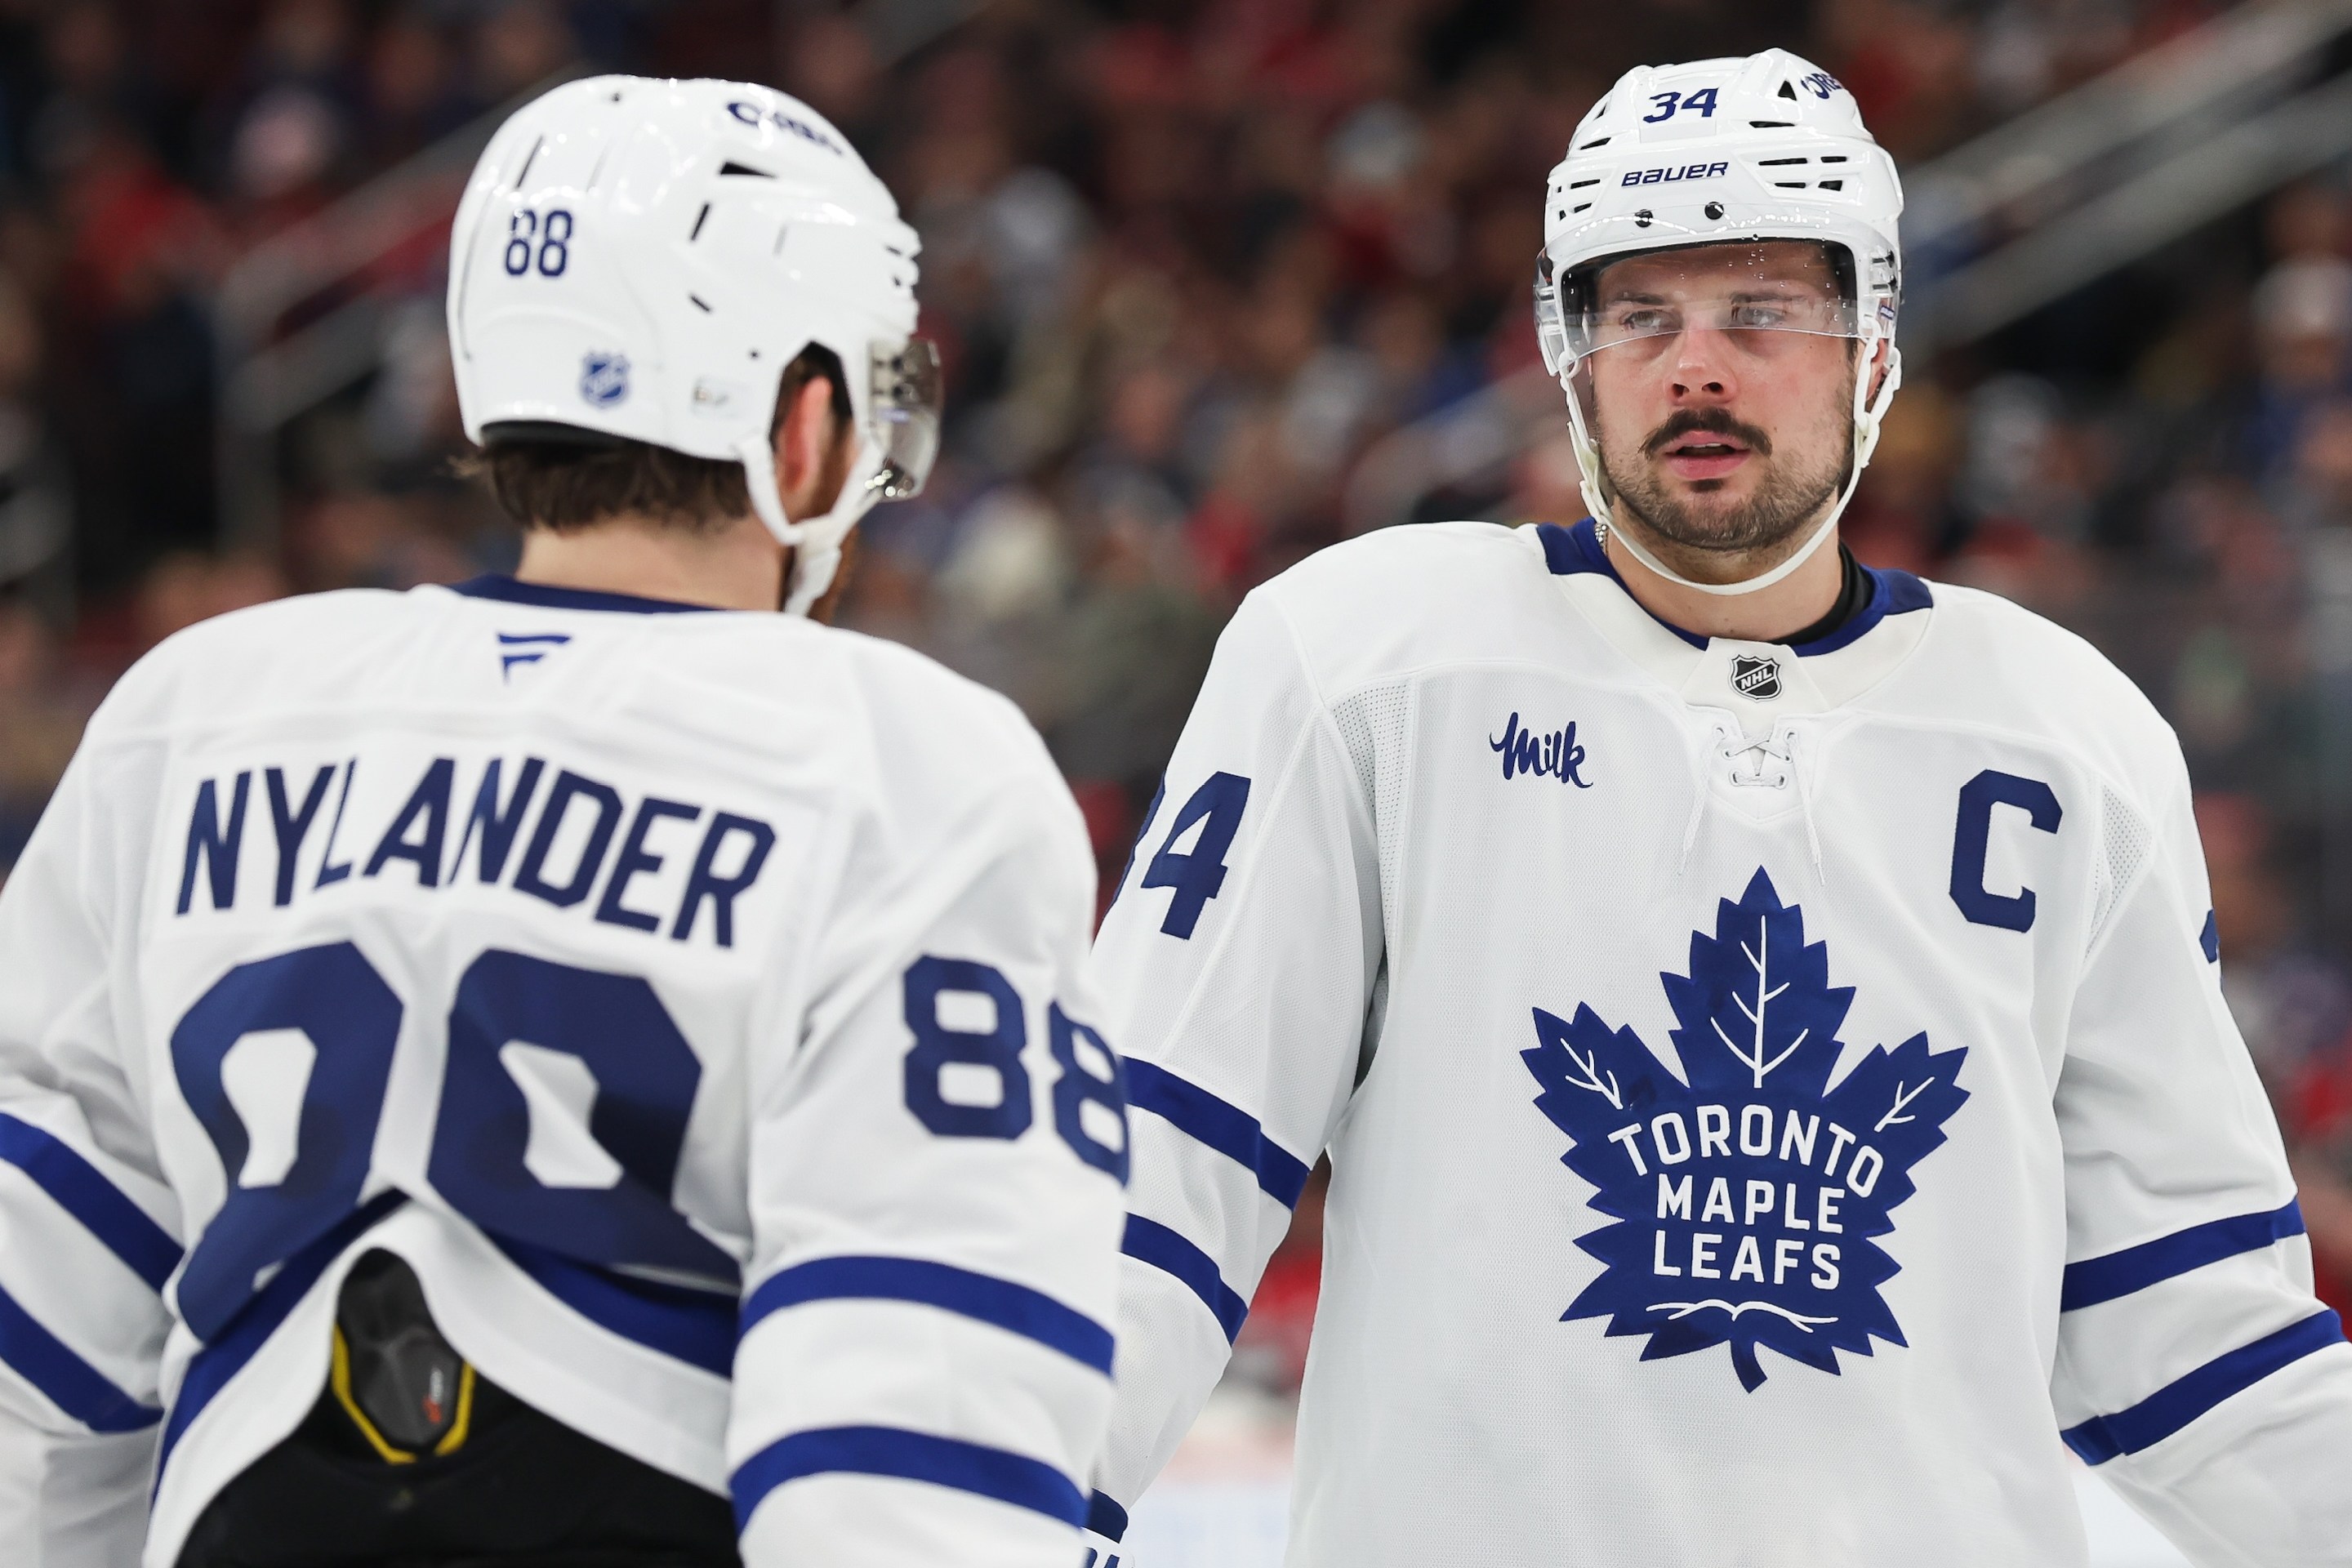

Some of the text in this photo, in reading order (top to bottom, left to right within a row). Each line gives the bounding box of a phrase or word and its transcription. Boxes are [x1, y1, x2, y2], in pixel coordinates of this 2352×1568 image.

[1642, 87, 1719, 123] 34
[505, 208, 572, 276] 88
[1740, 667, 1772, 690] NHL
[1489, 711, 1593, 789] Milk
[174, 755, 778, 949] NYLANDER
[1104, 770, 1251, 941] 4
[1949, 768, 2063, 933] C
[902, 954, 1131, 1189] 88
[1607, 1104, 1883, 1198] TORONTO
[1655, 1174, 1846, 1234] MAPLE
[1653, 1229, 1841, 1290] LEAFS
